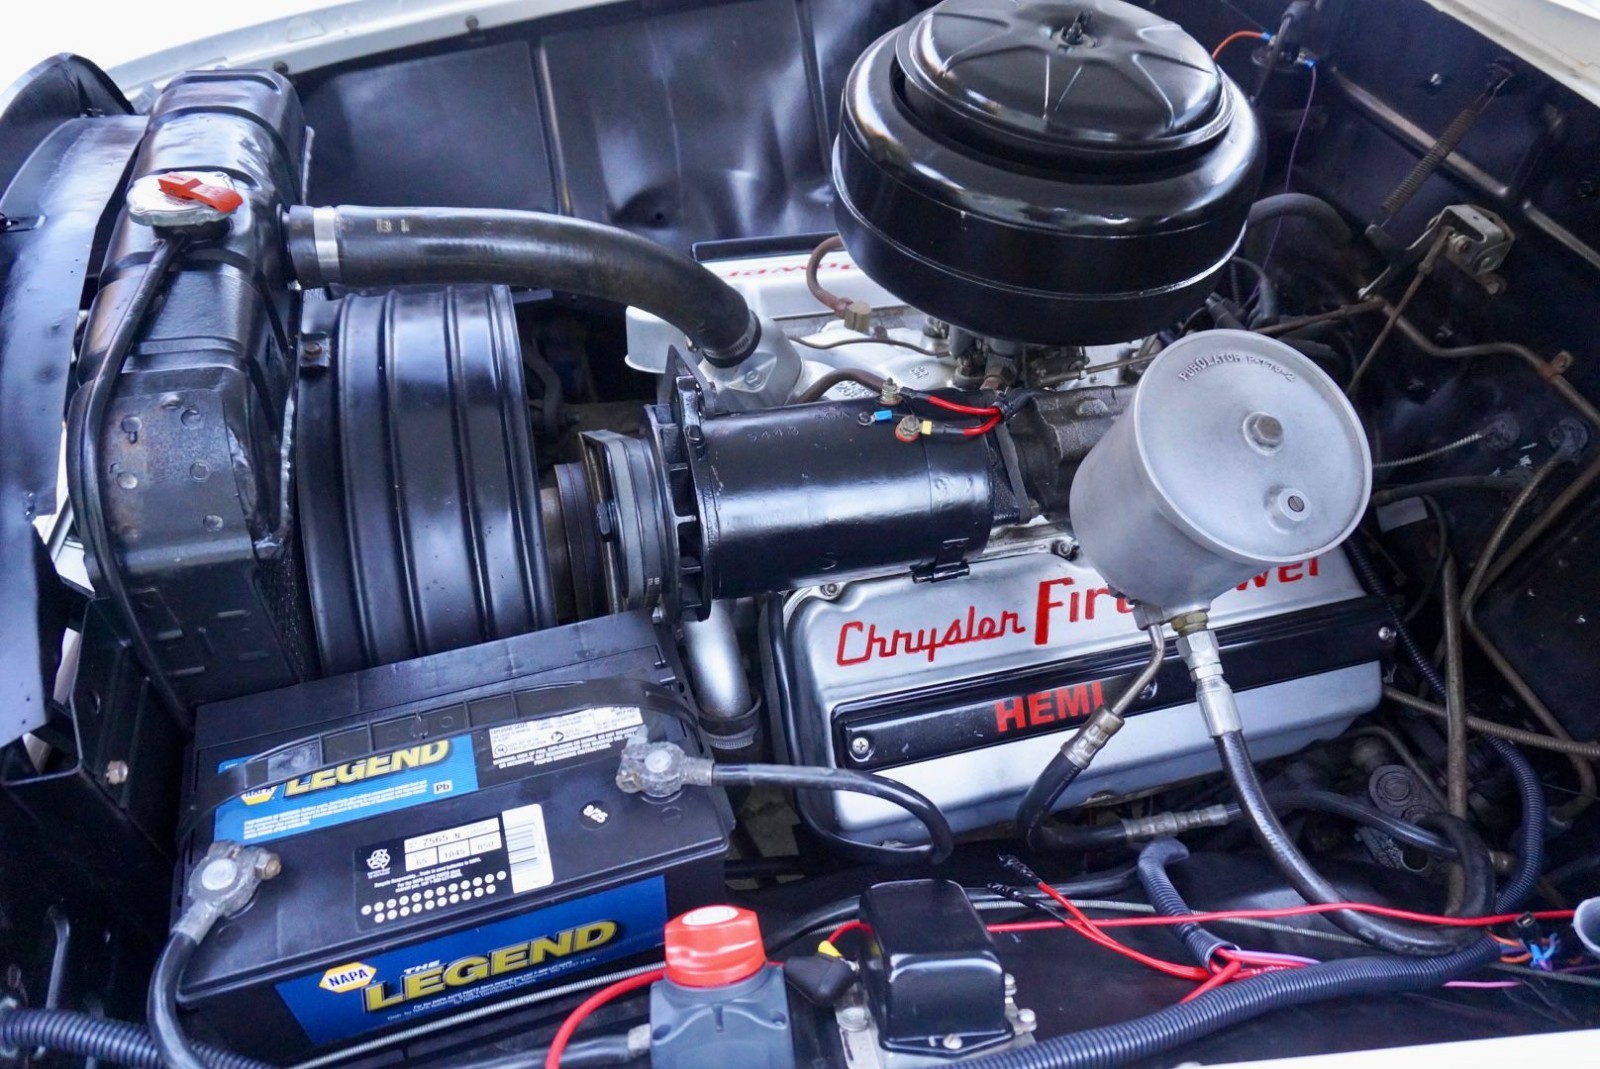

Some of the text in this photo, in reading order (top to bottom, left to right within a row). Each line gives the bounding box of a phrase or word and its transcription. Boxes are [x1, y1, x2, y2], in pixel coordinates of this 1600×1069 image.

[1178, 353, 1241, 381] PUROLATOR
[836, 606, 1026, 667] Chrysler
[994, 680, 1104, 733] HEMI
[284, 739, 450, 797] LEGEND
[435, 783, 450, 793] Pb
[328, 968, 369, 987] NAPA
[362, 919, 618, 1013] LEGEND
[404, 960, 440, 974] THE
